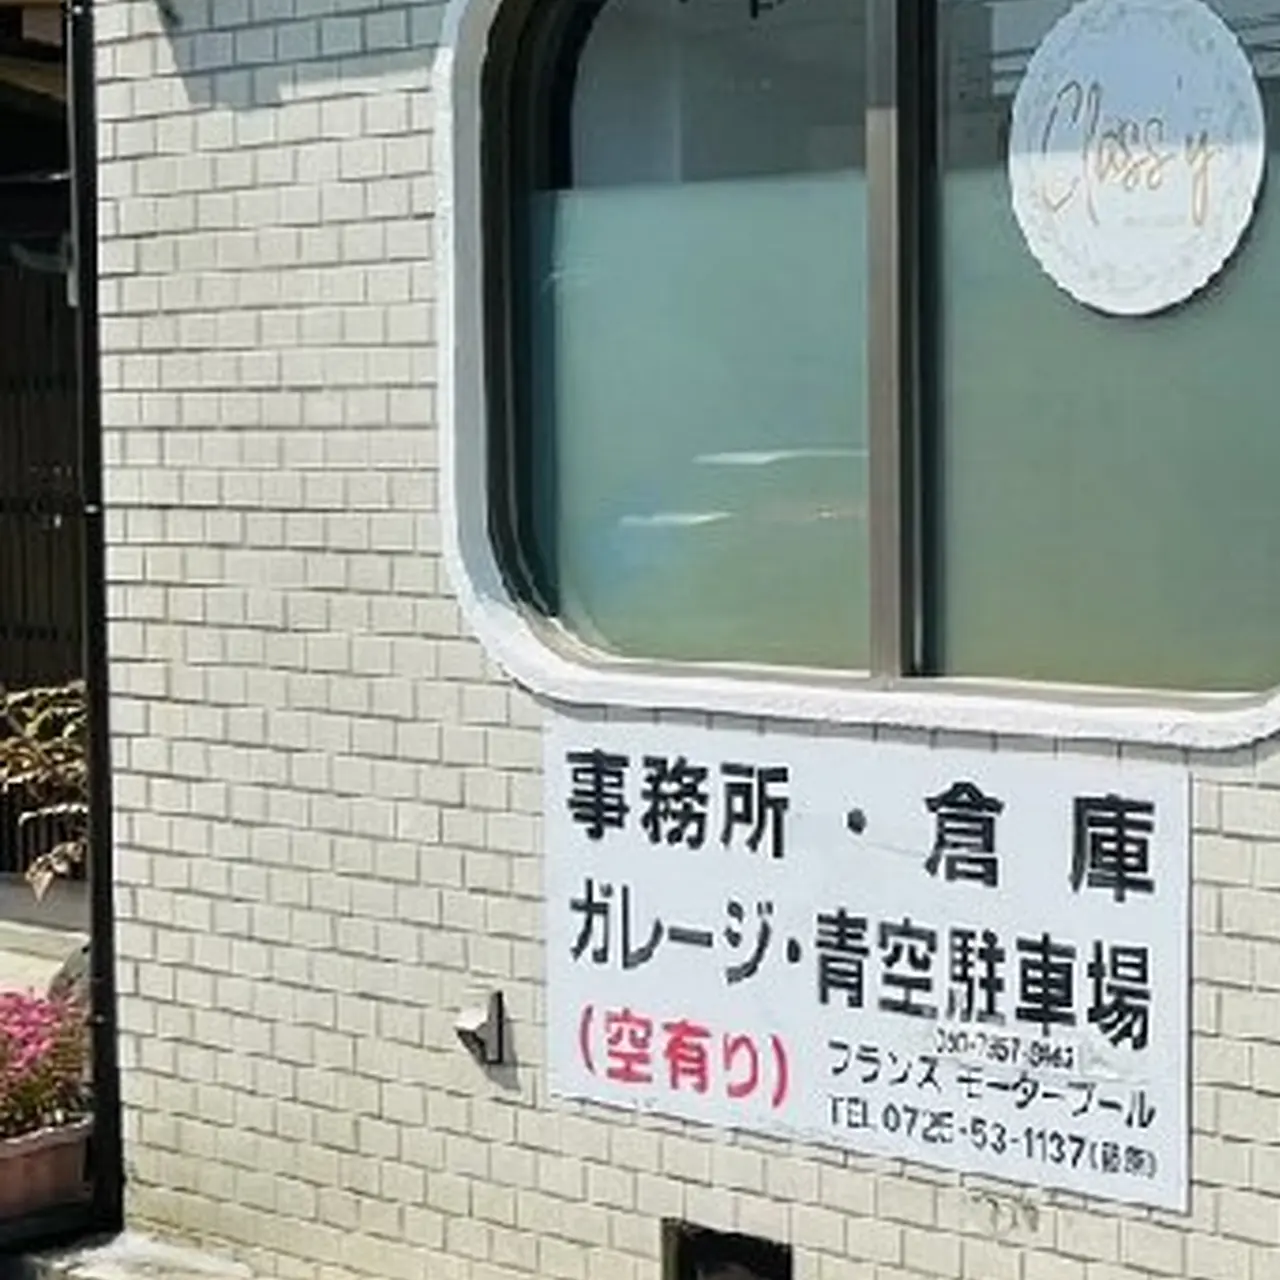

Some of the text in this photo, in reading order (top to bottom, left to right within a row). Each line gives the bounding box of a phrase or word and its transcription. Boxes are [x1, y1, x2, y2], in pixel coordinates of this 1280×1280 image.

[568, 876, 1152, 1052] ガレージ・青空駐車場
